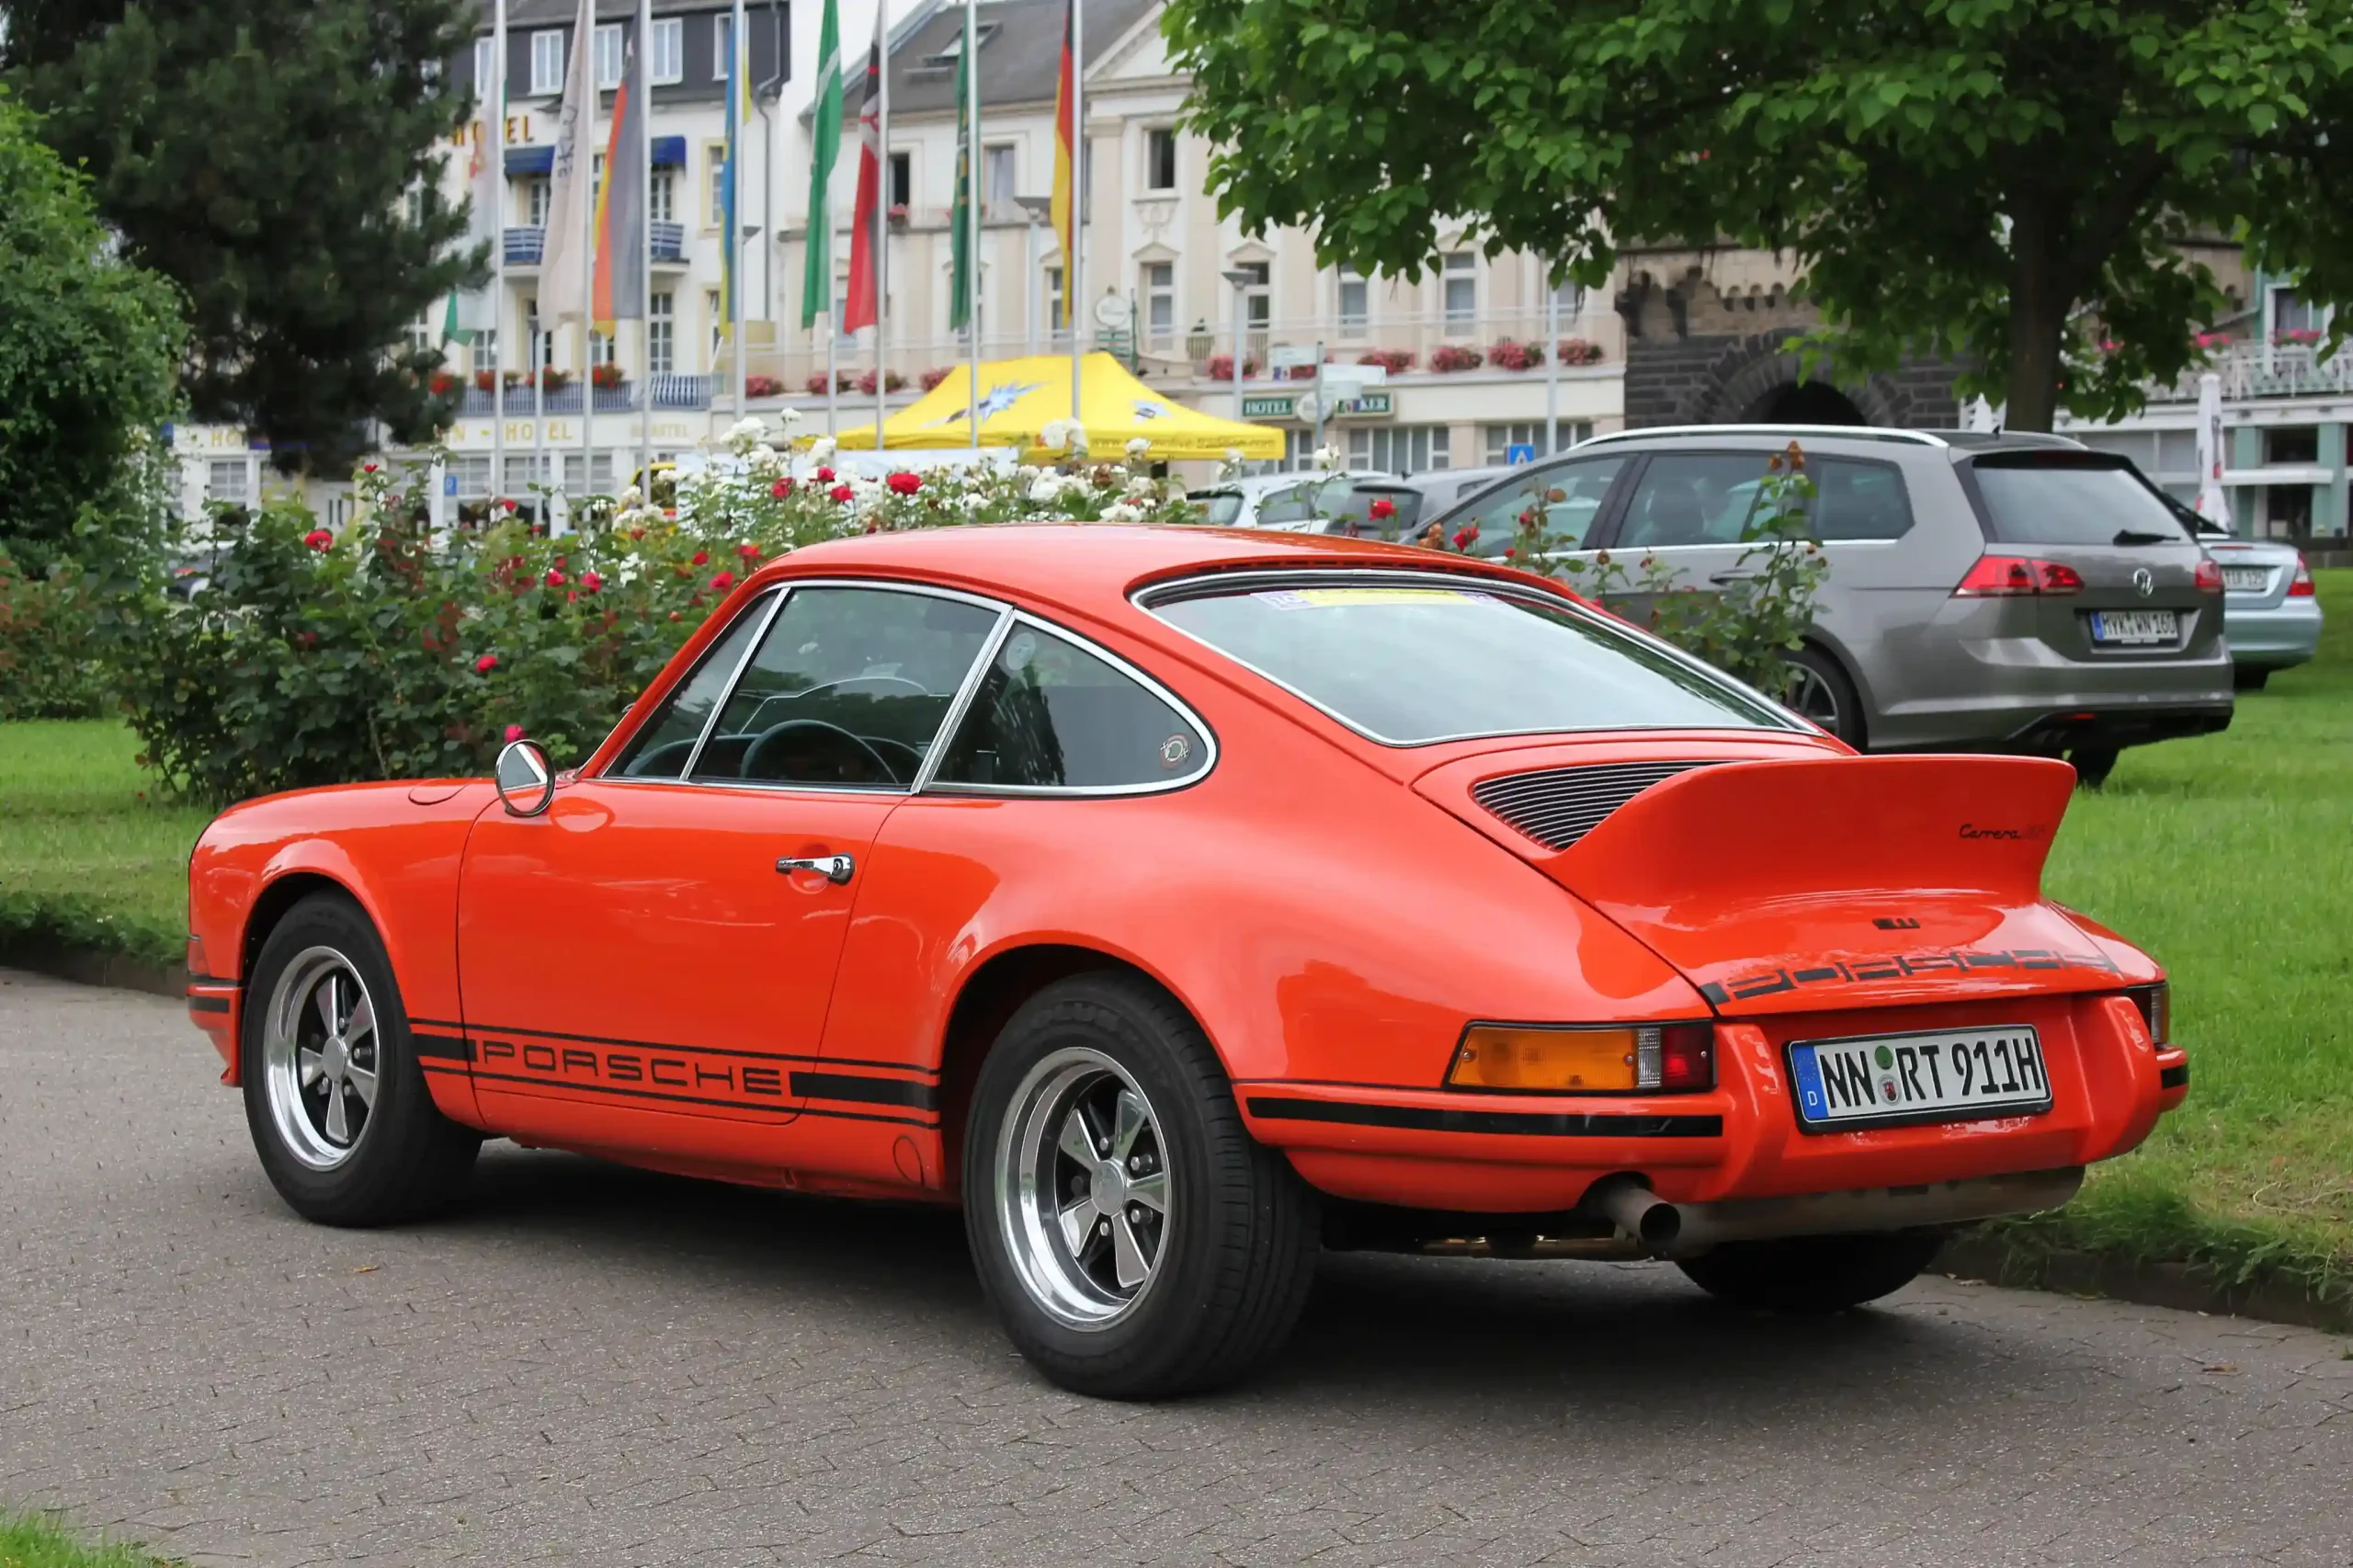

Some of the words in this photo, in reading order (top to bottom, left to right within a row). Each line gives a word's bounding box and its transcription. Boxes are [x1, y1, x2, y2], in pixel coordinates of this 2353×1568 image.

[451, 115, 534, 146] HOEL
[1245, 400, 1291, 415] HOTEL
[505, 422, 573, 441] HOEL
[1959, 823, 2022, 840] Carrera
[483, 1040, 782, 1096] PORSCHE
[1819, 1050, 1877, 1108] NN
[1894, 1044, 1944, 1102] RT
[1950, 1037, 2042, 1096] 911H
[1807, 1090, 1819, 1107] D
